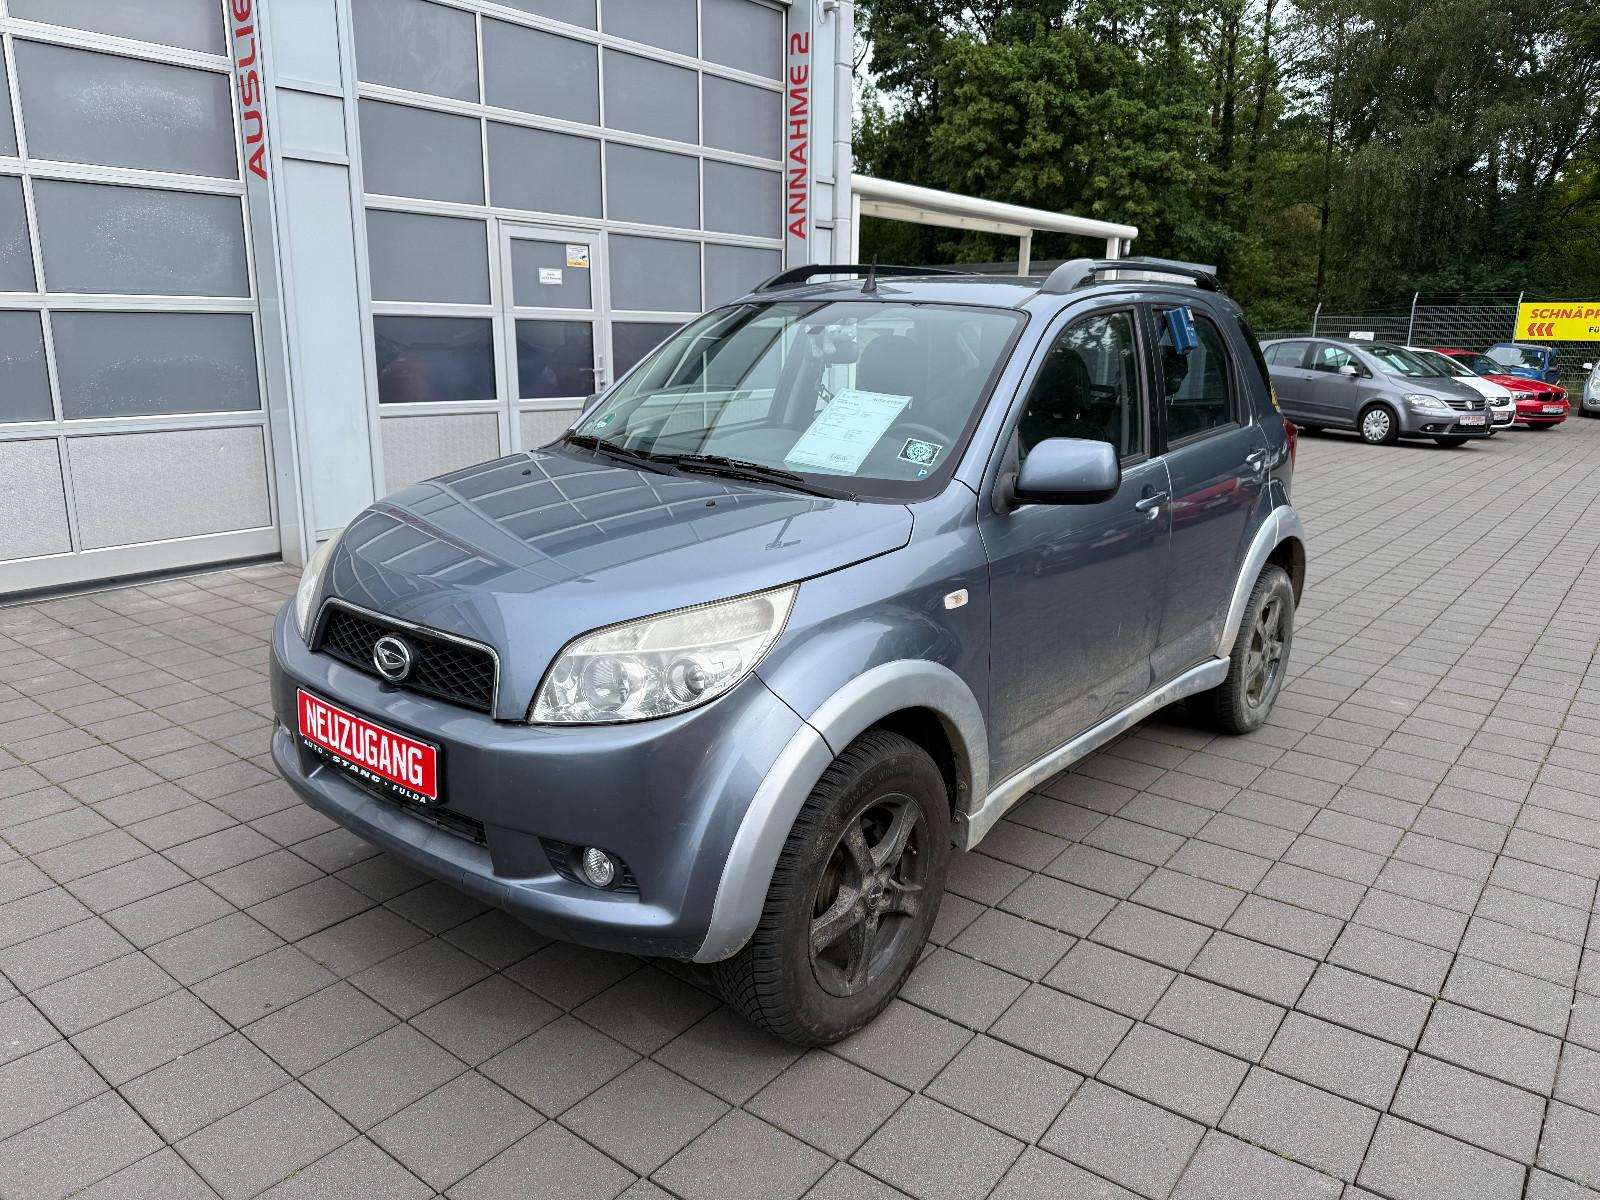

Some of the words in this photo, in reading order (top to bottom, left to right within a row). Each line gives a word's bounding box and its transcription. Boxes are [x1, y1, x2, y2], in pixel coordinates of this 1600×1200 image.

[790, 31, 809, 56] 2
[789, 64, 809, 239] ANNAHME
[303, 739, 323, 754] AUTO
[332, 755, 381, 783] STANG
[392, 784, 426, 804] FULDA
[306, 699, 423, 787] NEUZUGANG
